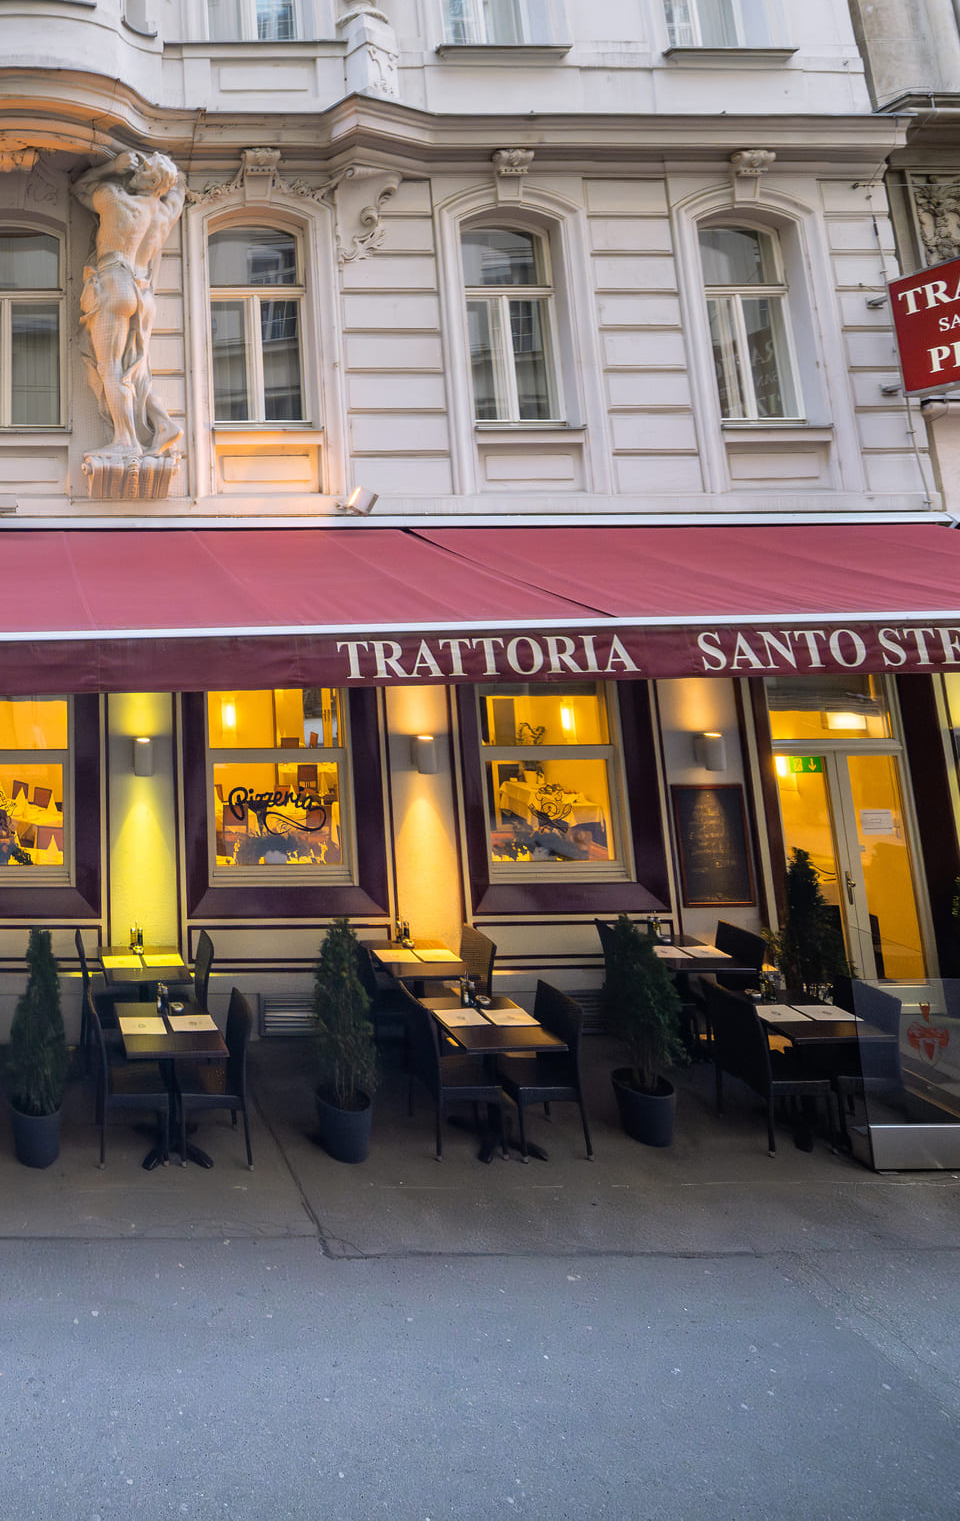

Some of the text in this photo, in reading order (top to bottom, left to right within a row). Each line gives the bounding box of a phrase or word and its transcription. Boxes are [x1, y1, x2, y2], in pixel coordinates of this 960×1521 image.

[336, 633, 642, 679] TRATTORIA
[696, 627, 960, 671] SANTO STE
[228, 786, 327, 836] Pizzeria
